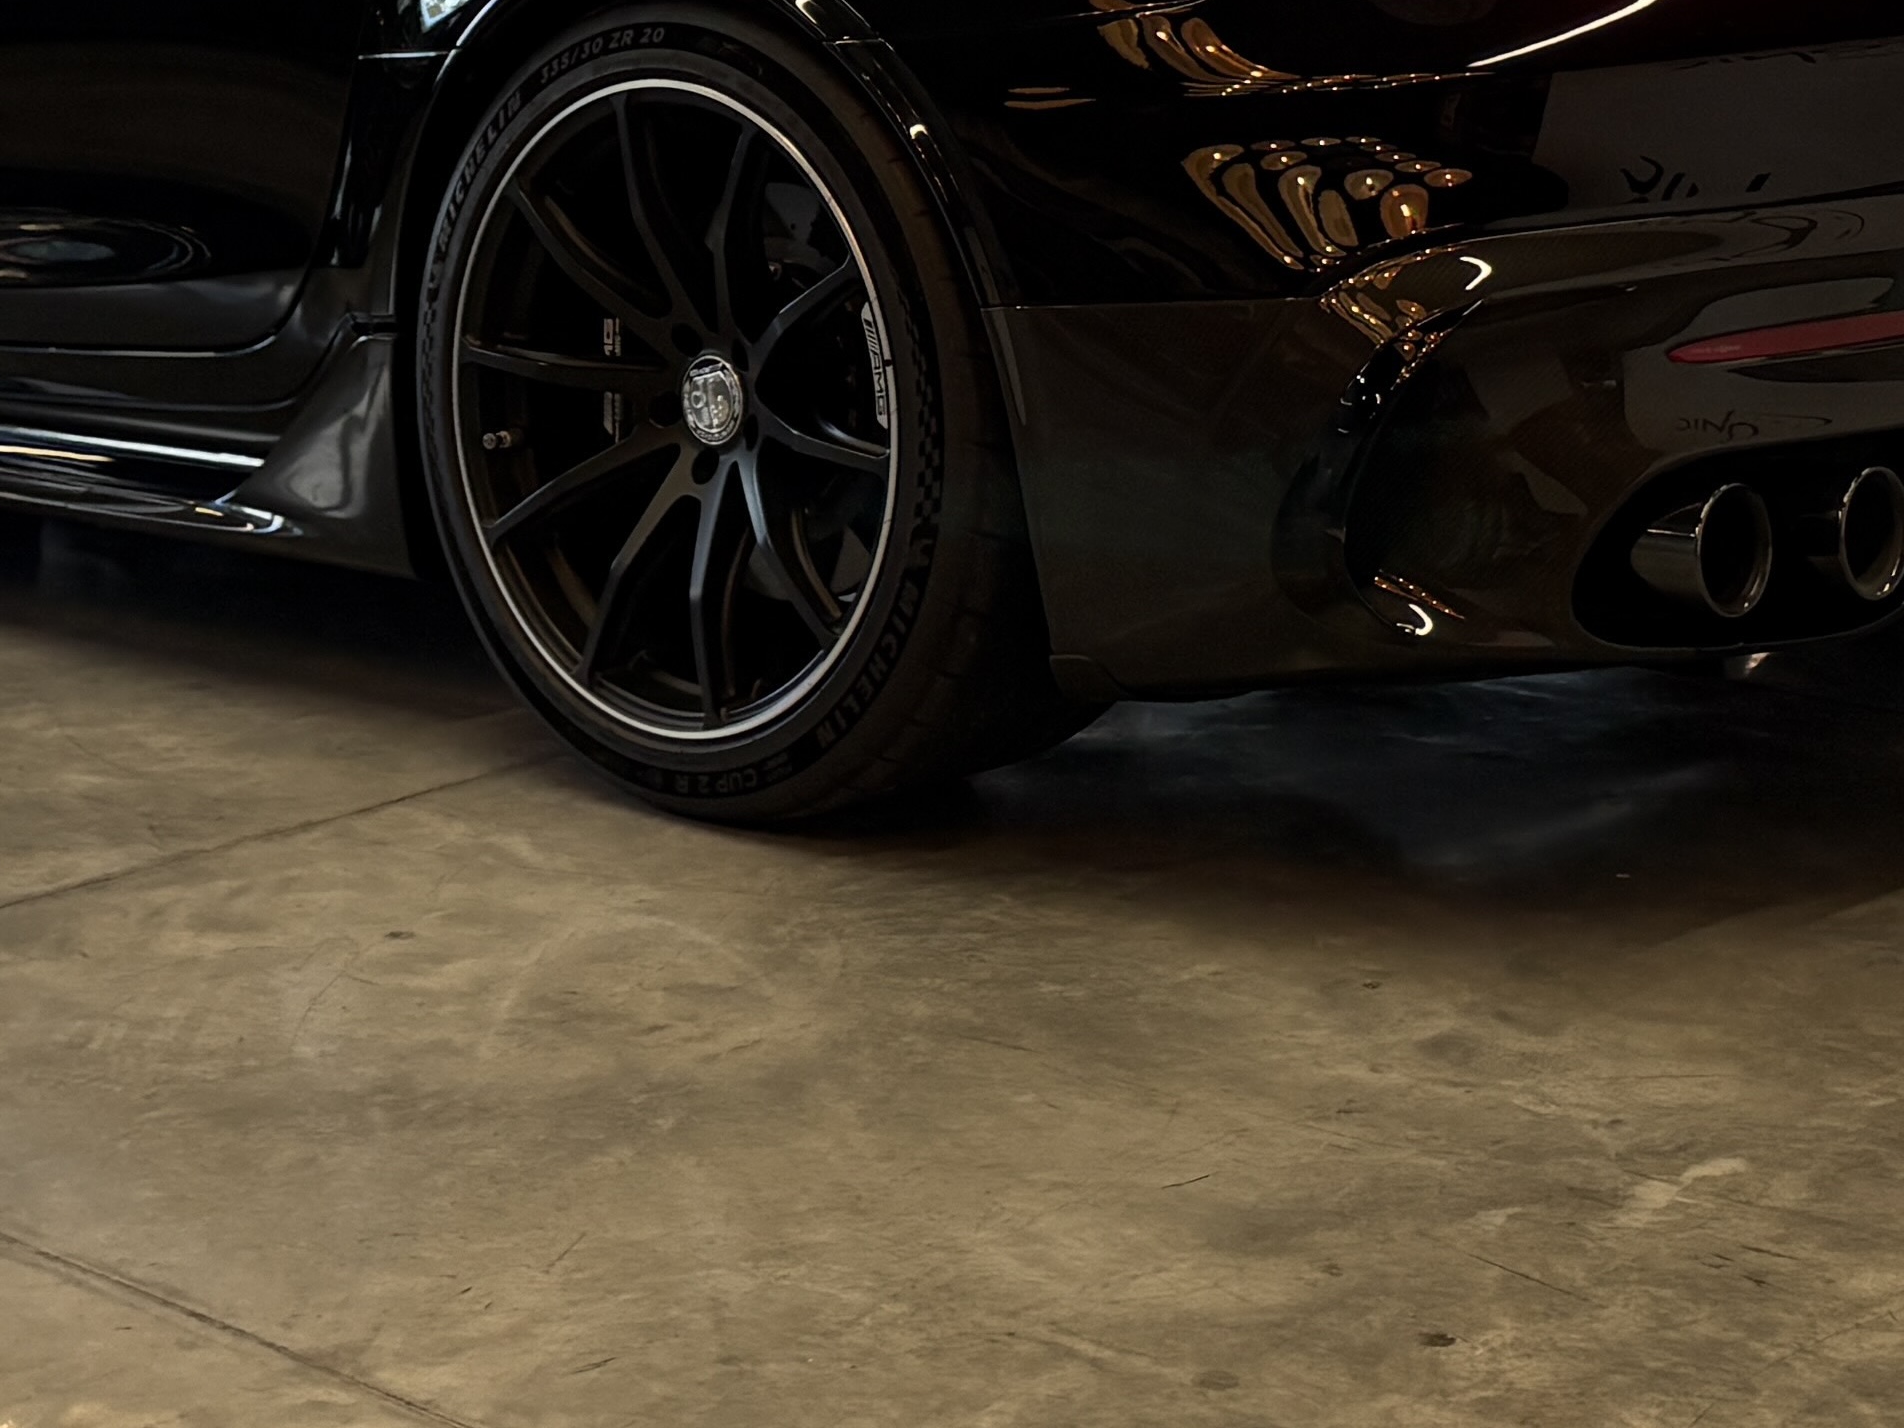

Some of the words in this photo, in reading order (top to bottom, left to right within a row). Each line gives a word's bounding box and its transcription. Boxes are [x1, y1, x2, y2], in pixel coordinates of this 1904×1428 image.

[608, 28, 635, 50] ZR
[639, 26, 666, 44] 20
[437, 89, 523, 250] MICHELIN
[675, 773, 691, 793] R
[696, 773, 710, 793] 2
[716, 766, 759, 792] CUP
